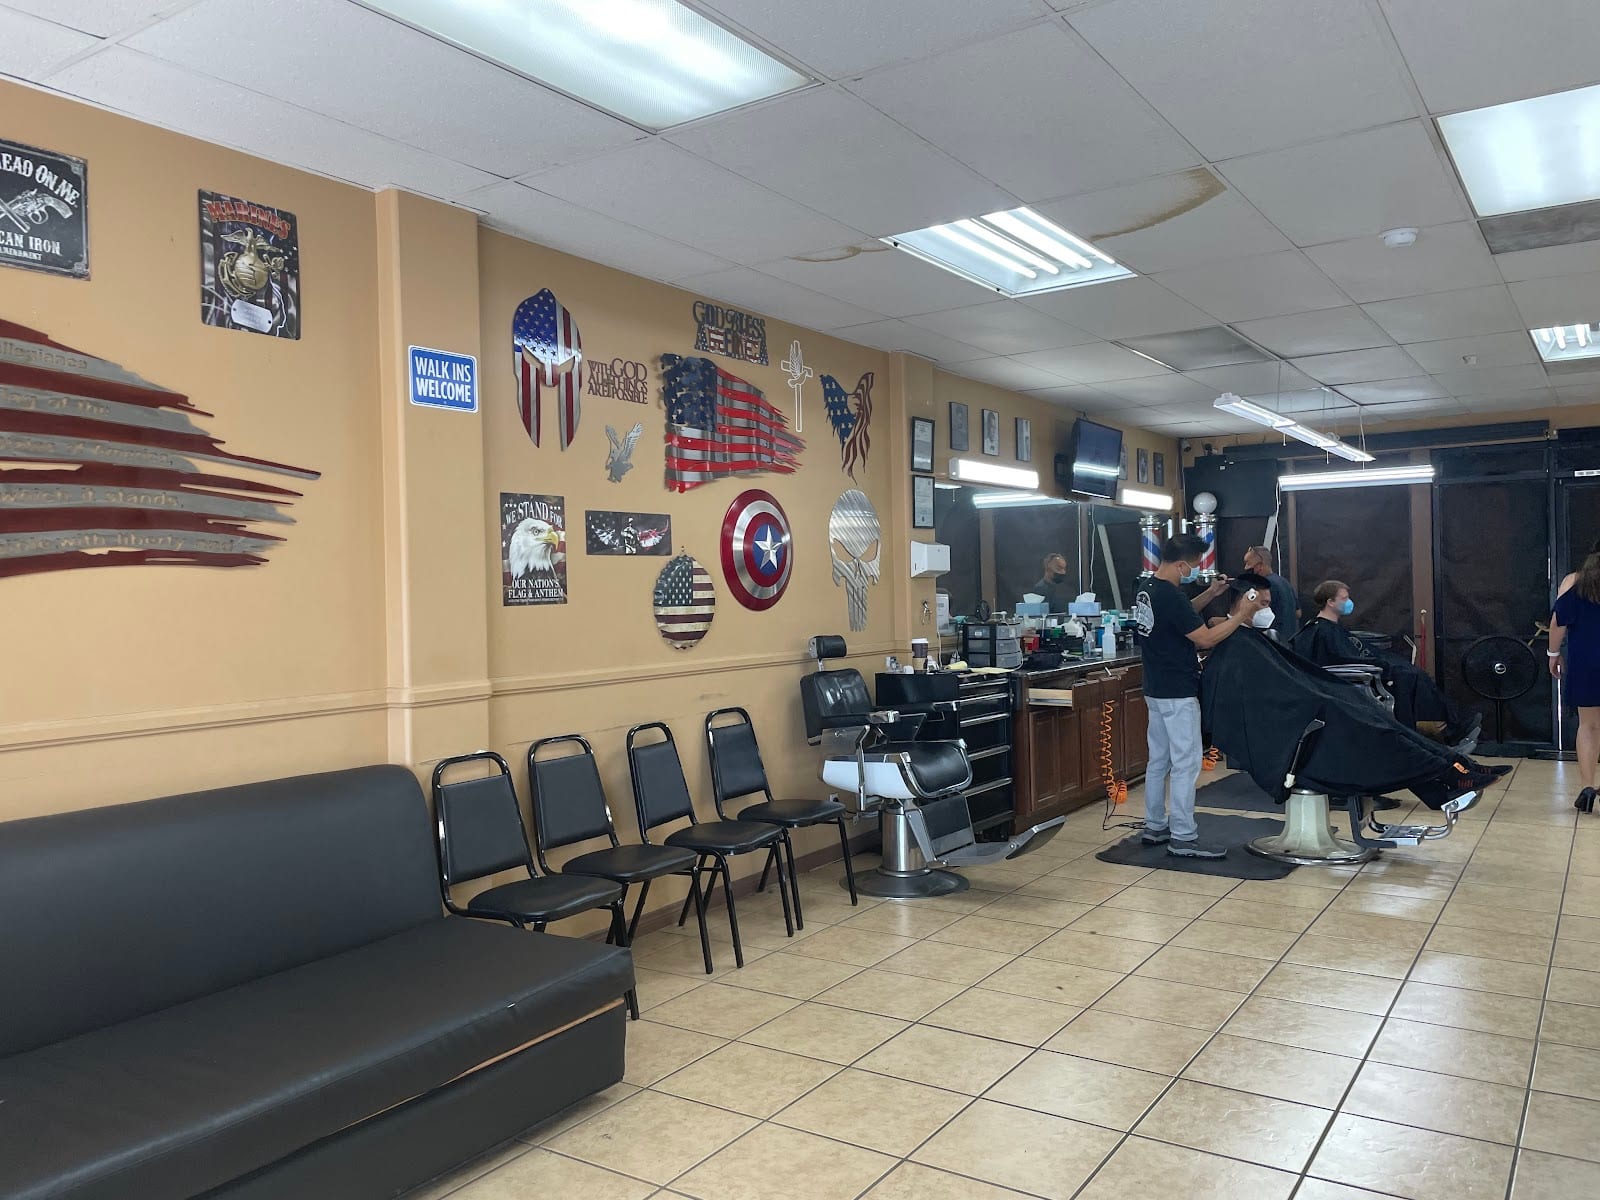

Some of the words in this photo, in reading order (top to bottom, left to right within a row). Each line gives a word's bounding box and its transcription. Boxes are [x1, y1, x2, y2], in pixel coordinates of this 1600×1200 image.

[0, 152, 33, 177] EAD
[35, 165, 58, 190] ON
[206, 201, 291, 240] MARINES
[28, 236, 62, 256] IRON
[693, 301, 724, 329] GOD
[0, 340, 88, 369] llegiance
[415, 355, 449, 380] WALK
[452, 362, 471, 382] INS
[587, 360, 612, 375] WITH
[612, 357, 647, 381] GOD
[416, 377, 471, 403] WELCOME
[611, 374, 647, 393] THINGS
[505, 510, 517, 525] WE
[517, 501, 549, 521] STAND
[550, 510, 563, 529] FOR
[508, 588, 527, 599] FLAG
[528, 589, 533, 598] &
[535, 587, 564, 598] ANTHEM
[512, 579, 527, 589] OUR
